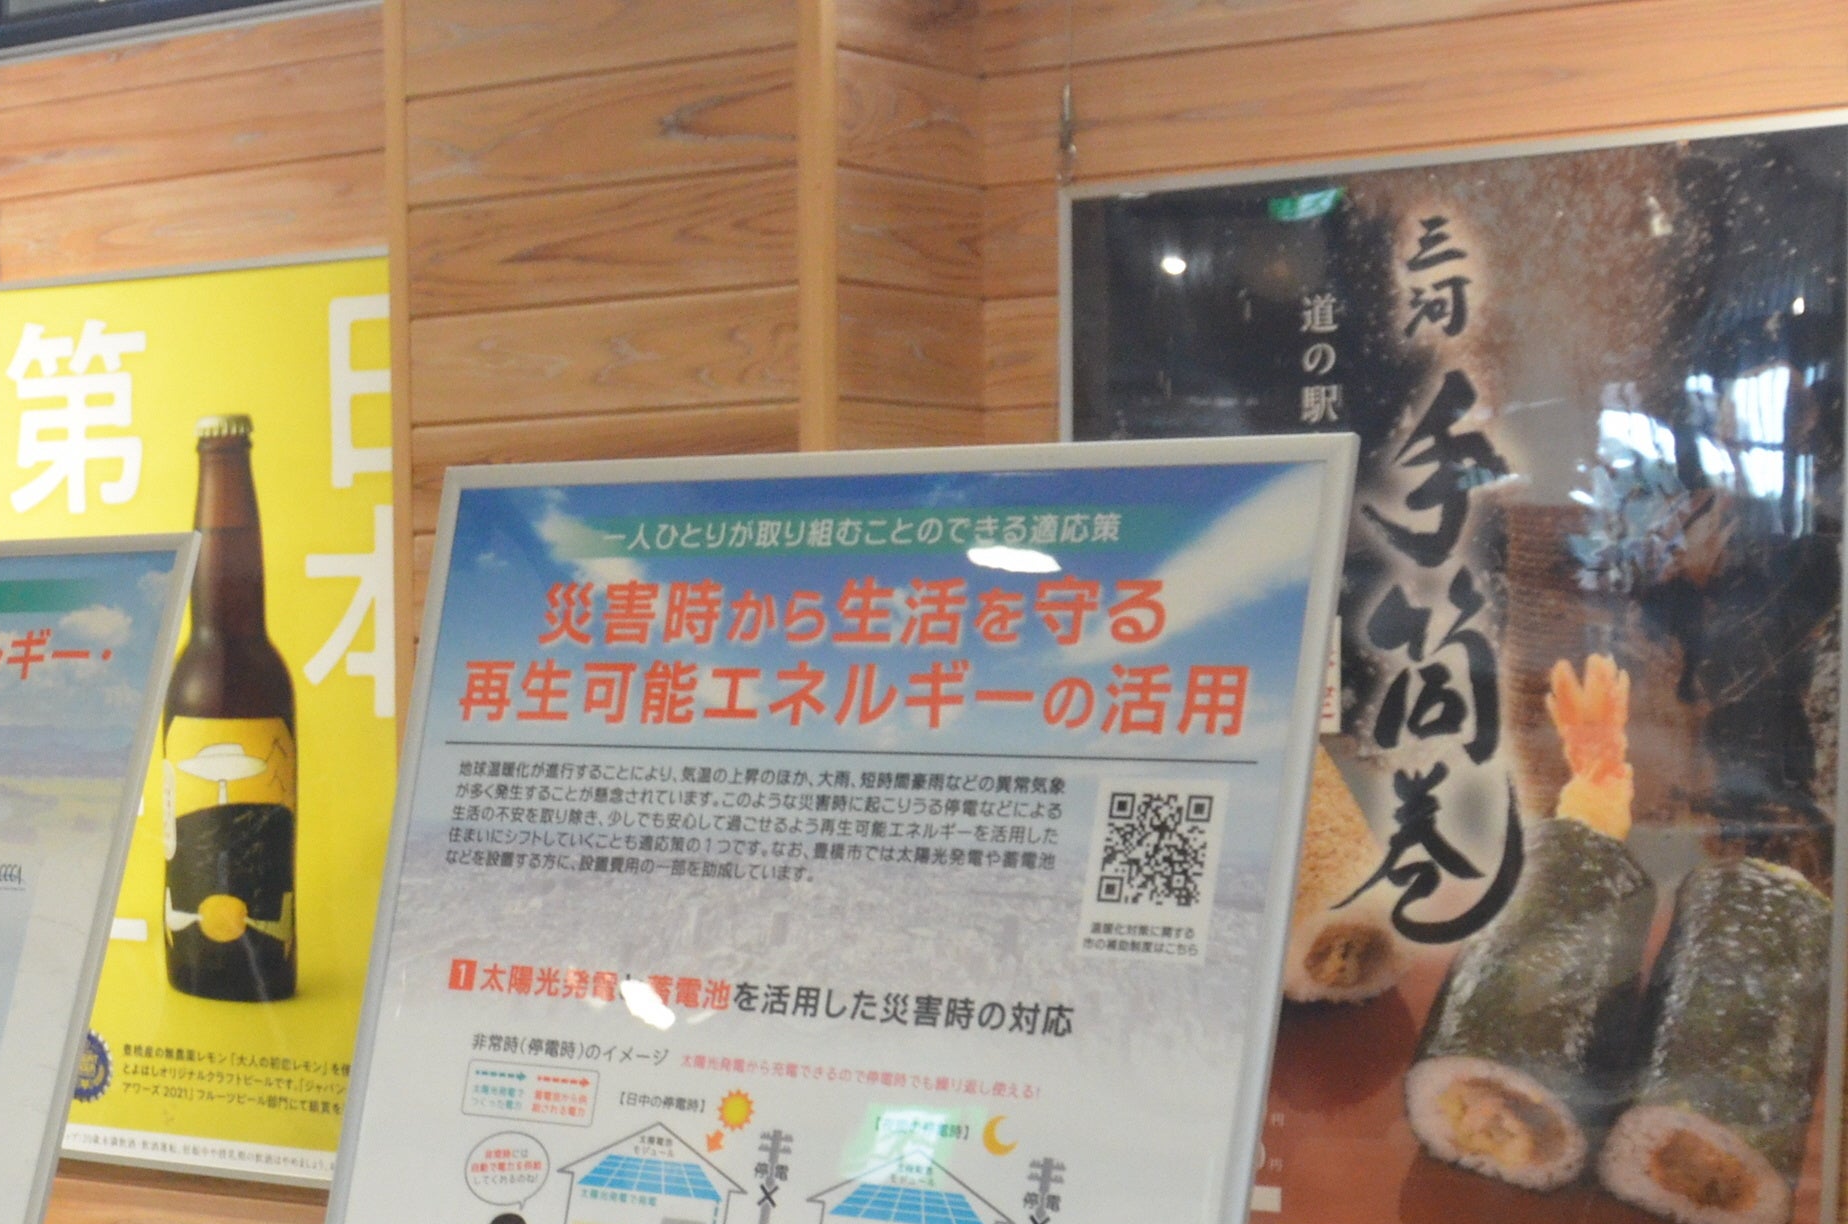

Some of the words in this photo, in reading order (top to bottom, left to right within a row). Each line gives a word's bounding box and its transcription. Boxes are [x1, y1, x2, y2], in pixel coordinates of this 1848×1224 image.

[1403, 215, 1474, 338] 三河
[1301, 294, 1339, 424] 道の駅
[7, 318, 146, 514] 第
[602, 510, 1122, 553] 一人ひとりが取り組むことのできる適応策
[536, 577, 1167, 648] 災害時から生活を守る
[1330, 370, 1525, 945] 手筒巻
[458, 659, 1248, 740] 再生可能エネルギーの活用
[455, 784, 1063, 820] が多く発生することが懸念されています。このような災害時に起こりうる停電などによる
[459, 760, 1066, 796] 地球温暖化が進行することにより、気温の上昇のほか、大雨、短時間豪雨などの異常気象
[452, 805, 1059, 845] 生活の不安を取り除き、少しでも安心して過ごせるよう再生可能エネルギーを活用した
[445, 849, 814, 883] などを設置する方に、設置費用の一部を助成しています。
[480, 963, 1074, 1038] 太陽光発電蓄電池を活用した災害時の対応
[619, 1090, 705, 1114] 【日中の停電時】
